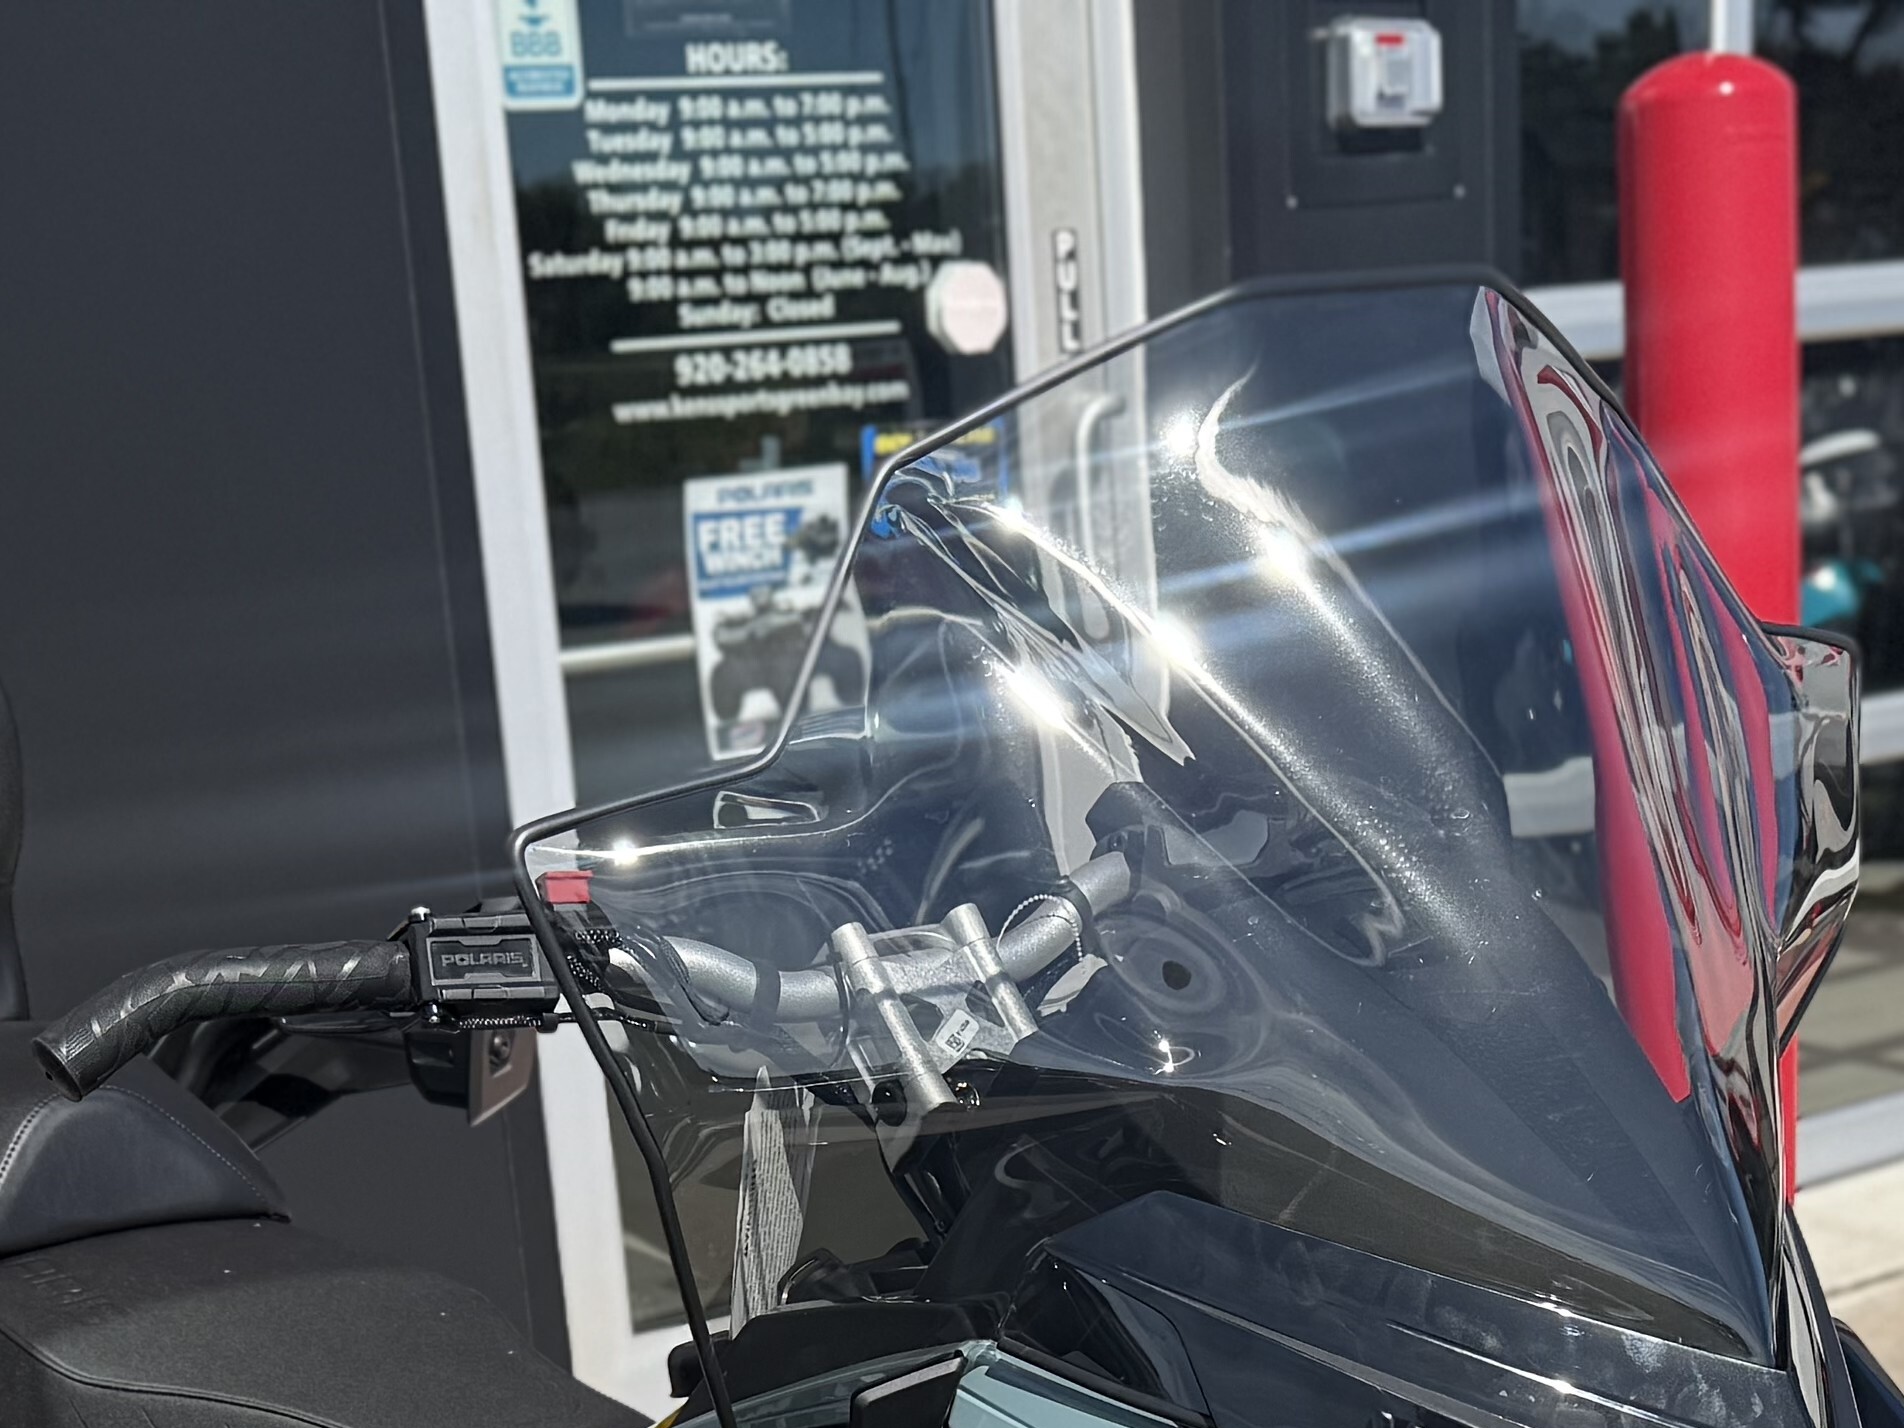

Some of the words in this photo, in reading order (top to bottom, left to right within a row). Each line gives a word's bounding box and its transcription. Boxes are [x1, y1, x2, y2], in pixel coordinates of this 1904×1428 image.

[685, 40, 789, 74] HOURS:
[584, 97, 672, 127] Monday
[678, 95, 724, 120] 9:00
[773, 95, 798, 118] to
[586, 126, 674, 156] Tuesday
[680, 125, 726, 150] 9:00
[776, 125, 800, 147] to
[571, 156, 692, 187] Wednesday
[699, 154, 746, 180] 9:00
[793, 153, 817, 176] to
[586, 185, 684, 217] Thursday
[690, 183, 736, 209] 9:00
[784, 182, 809, 205] to
[604, 216, 672, 246] Friday
[677, 214, 723, 241] 9:00
[773, 213, 798, 236] to
[527, 249, 625, 280] Saturday
[625, 246, 672, 272] 9:00
[721, 244, 747, 268] to
[626, 276, 674, 303] 9:00
[723, 273, 748, 297] to
[1056, 230, 1081, 351] PULL
[678, 301, 761, 330] Sunday:
[766, 294, 836, 323] Closed
[698, 511, 787, 552] FREE
[705, 546, 785, 578] WINCH
[440, 951, 525, 968] POLARIS
